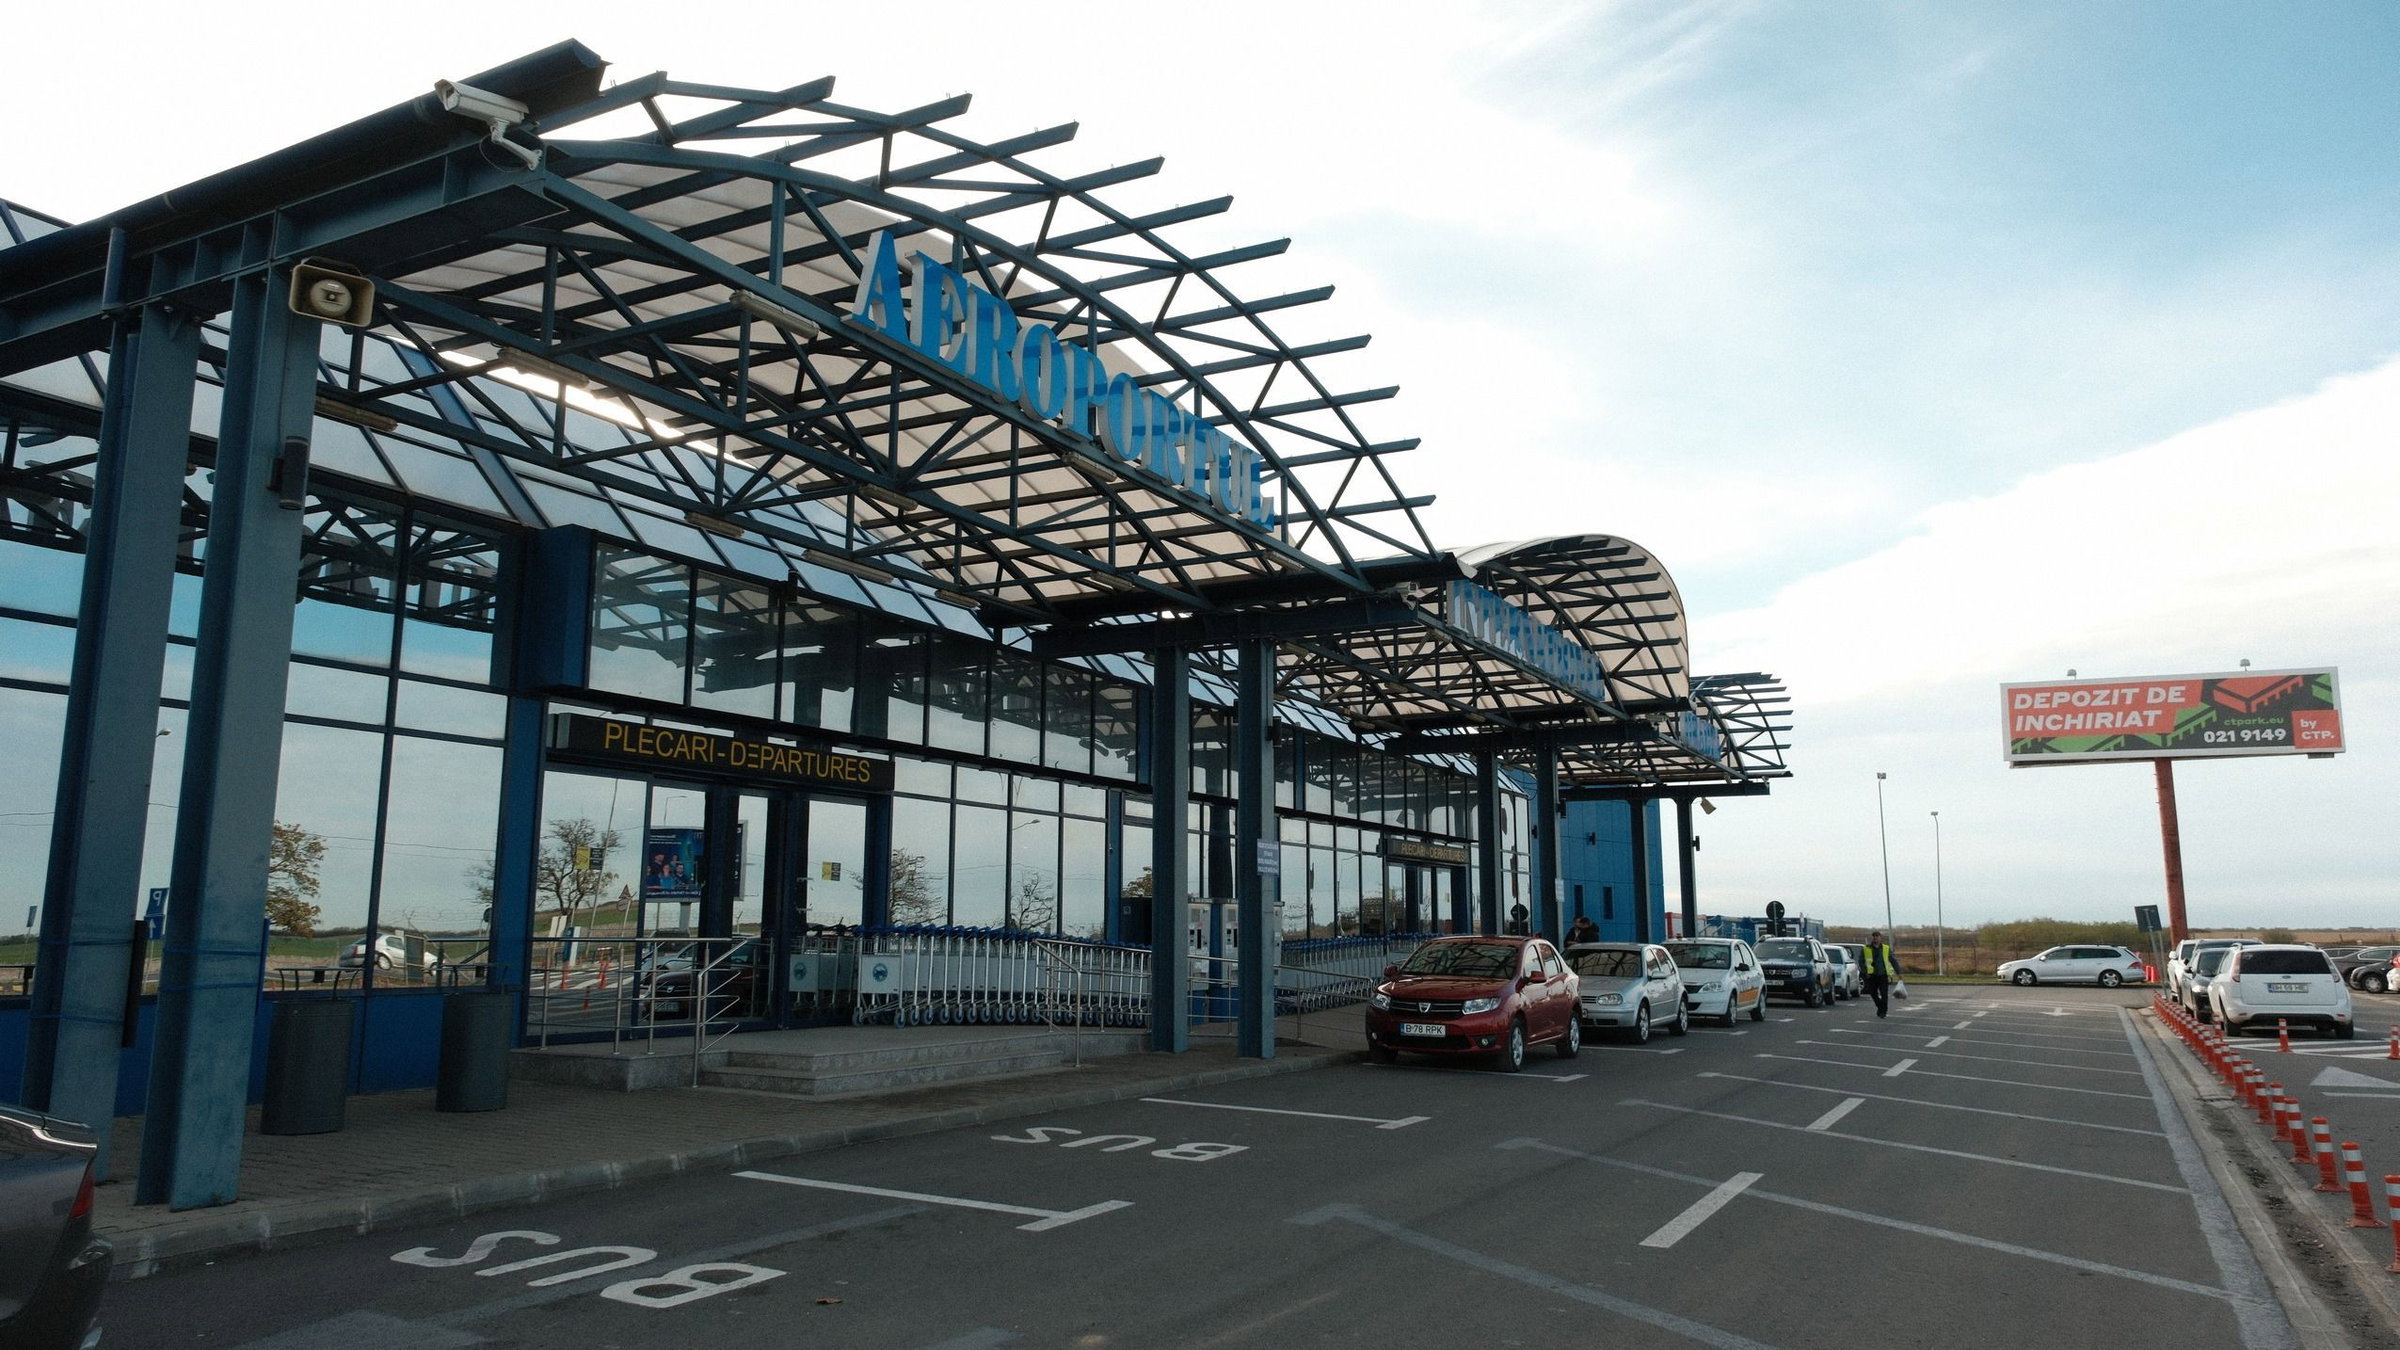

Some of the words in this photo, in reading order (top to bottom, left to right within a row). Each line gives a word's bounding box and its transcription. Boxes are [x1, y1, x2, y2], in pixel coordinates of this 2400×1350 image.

[841, 230, 1275, 533] AEROPORTUL
[2014, 688, 2139, 709] DEPOZIT
[2147, 686, 2186, 704] DE
[2015, 710, 2162, 731] INCHIRIAT
[2223, 717, 2284, 727] ctpark.eu
[2300, 719, 2317, 729] by
[2203, 730, 2236, 743] 021
[2240, 728, 2287, 741] 9149
[990, 1127, 1250, 1161] BUS
[390, 1230, 788, 1308] BUS
